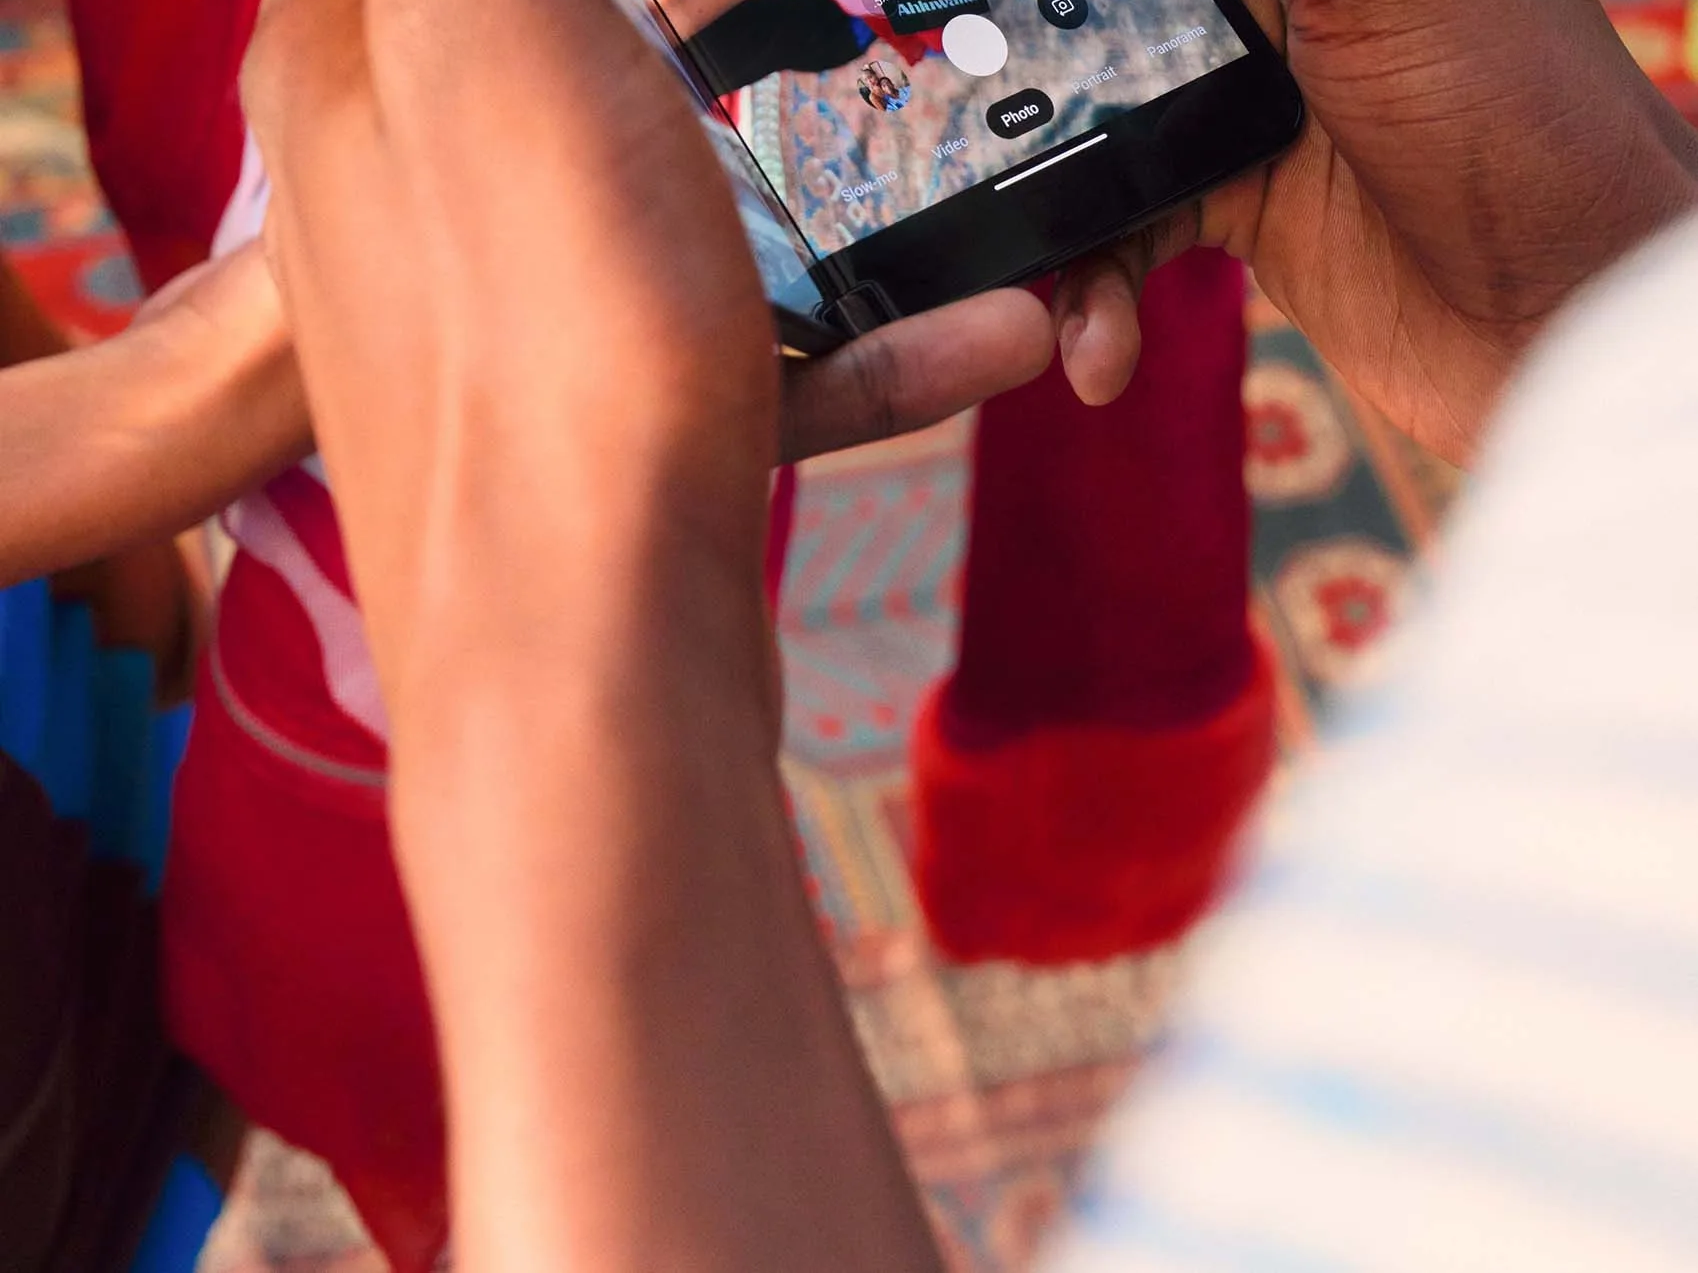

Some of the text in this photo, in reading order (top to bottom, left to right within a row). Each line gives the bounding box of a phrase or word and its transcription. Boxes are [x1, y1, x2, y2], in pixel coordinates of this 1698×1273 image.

[1146, 24, 1207, 58] Panorama
[1071, 64, 1118, 94] Portrait
[1000, 102, 1040, 128] Photo
[931, 135, 969, 160] Video
[840, 169, 898, 203] Slow-mo
